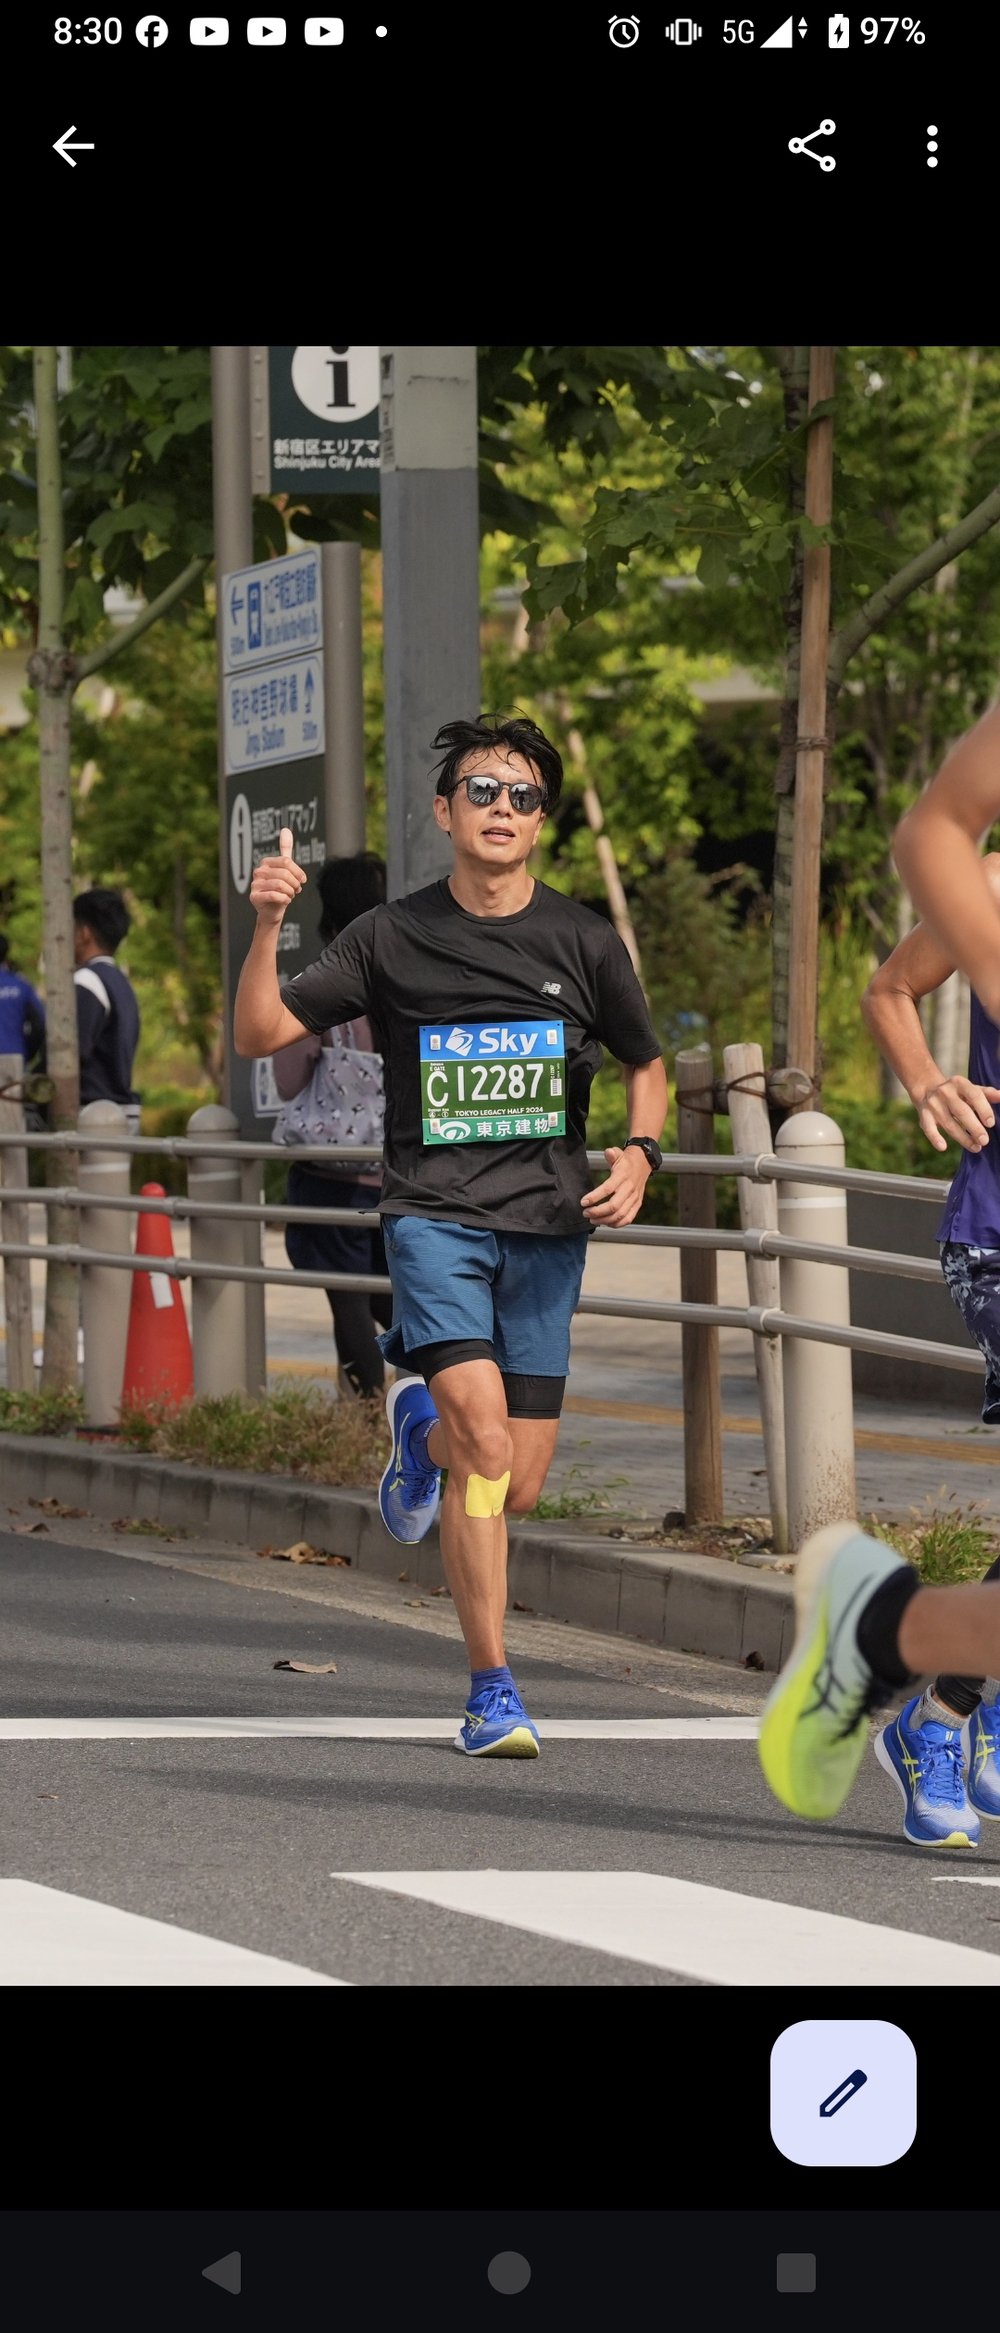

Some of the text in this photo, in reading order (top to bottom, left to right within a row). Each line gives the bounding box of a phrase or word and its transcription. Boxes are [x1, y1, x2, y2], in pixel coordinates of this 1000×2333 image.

[273, 456, 327, 471] Shinjuku
[328, 456, 352, 471] City
[478, 1028, 539, 1056] Sky
[457, 1063, 544, 1101] 12287
[480, 1108, 506, 1116] LEGACY
[476, 1117, 551, 1138] 東京建物
